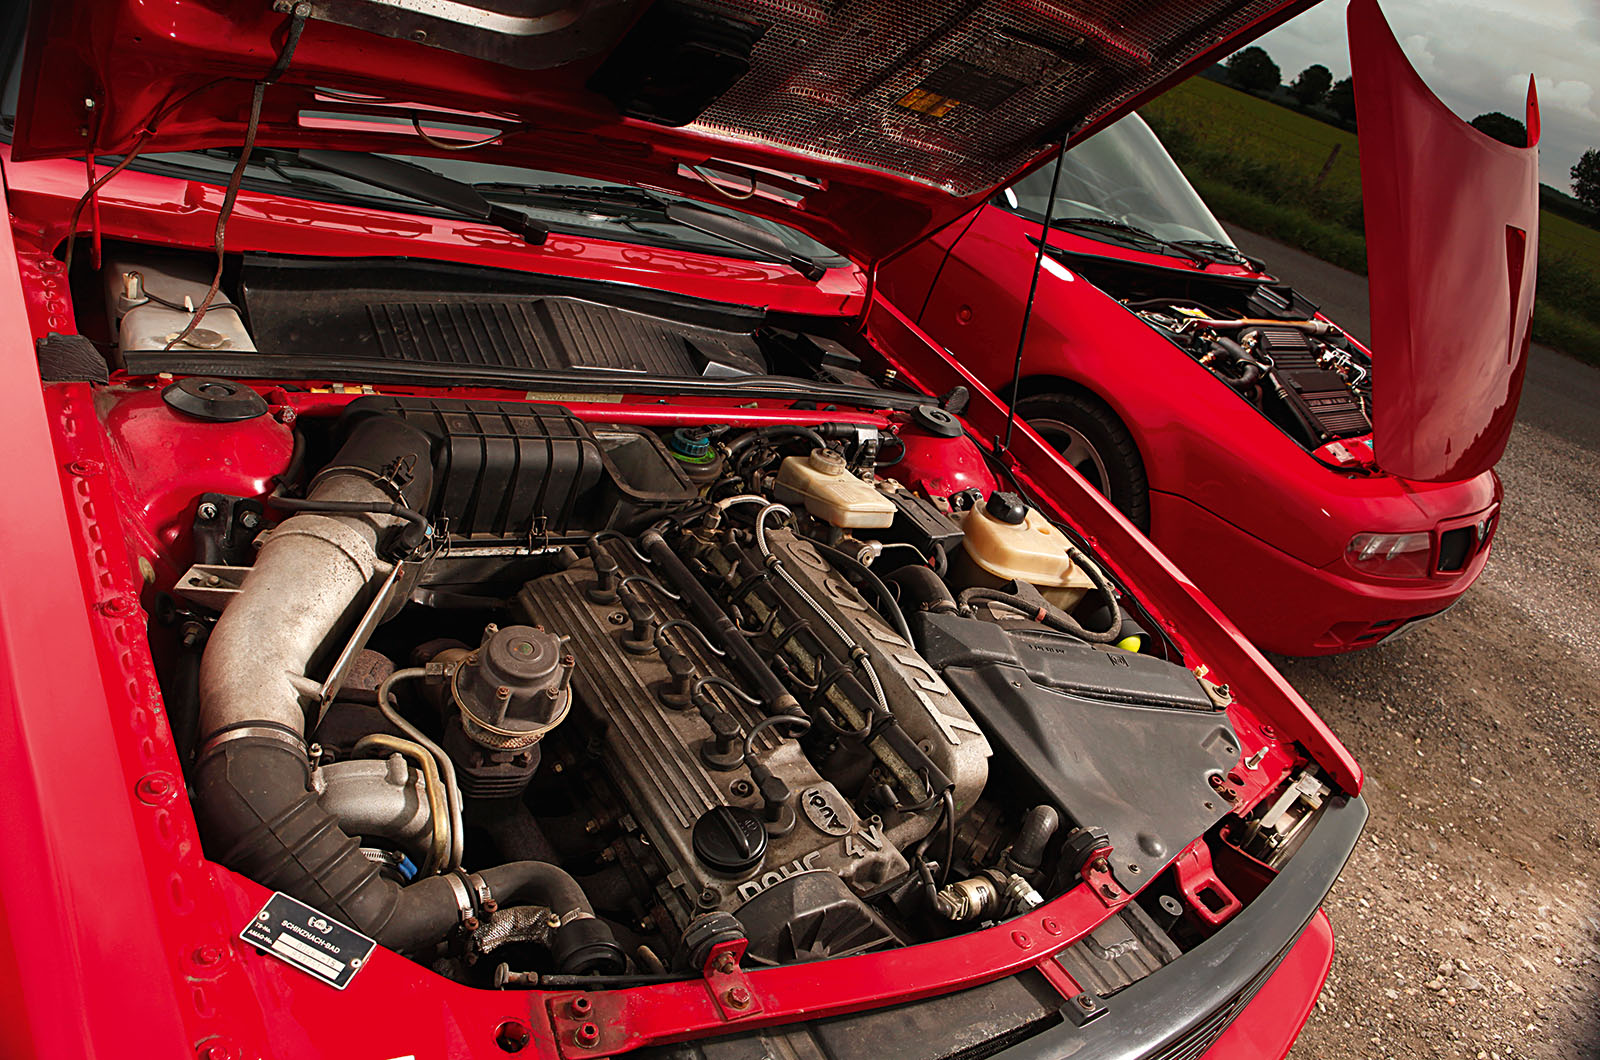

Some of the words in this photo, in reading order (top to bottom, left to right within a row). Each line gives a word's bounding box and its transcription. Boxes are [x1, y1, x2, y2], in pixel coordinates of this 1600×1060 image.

[807, 789, 848, 830] Audi
[844, 824, 883, 858] 4V
[281, 920, 341, 954] SCHINZNACH-BAD
